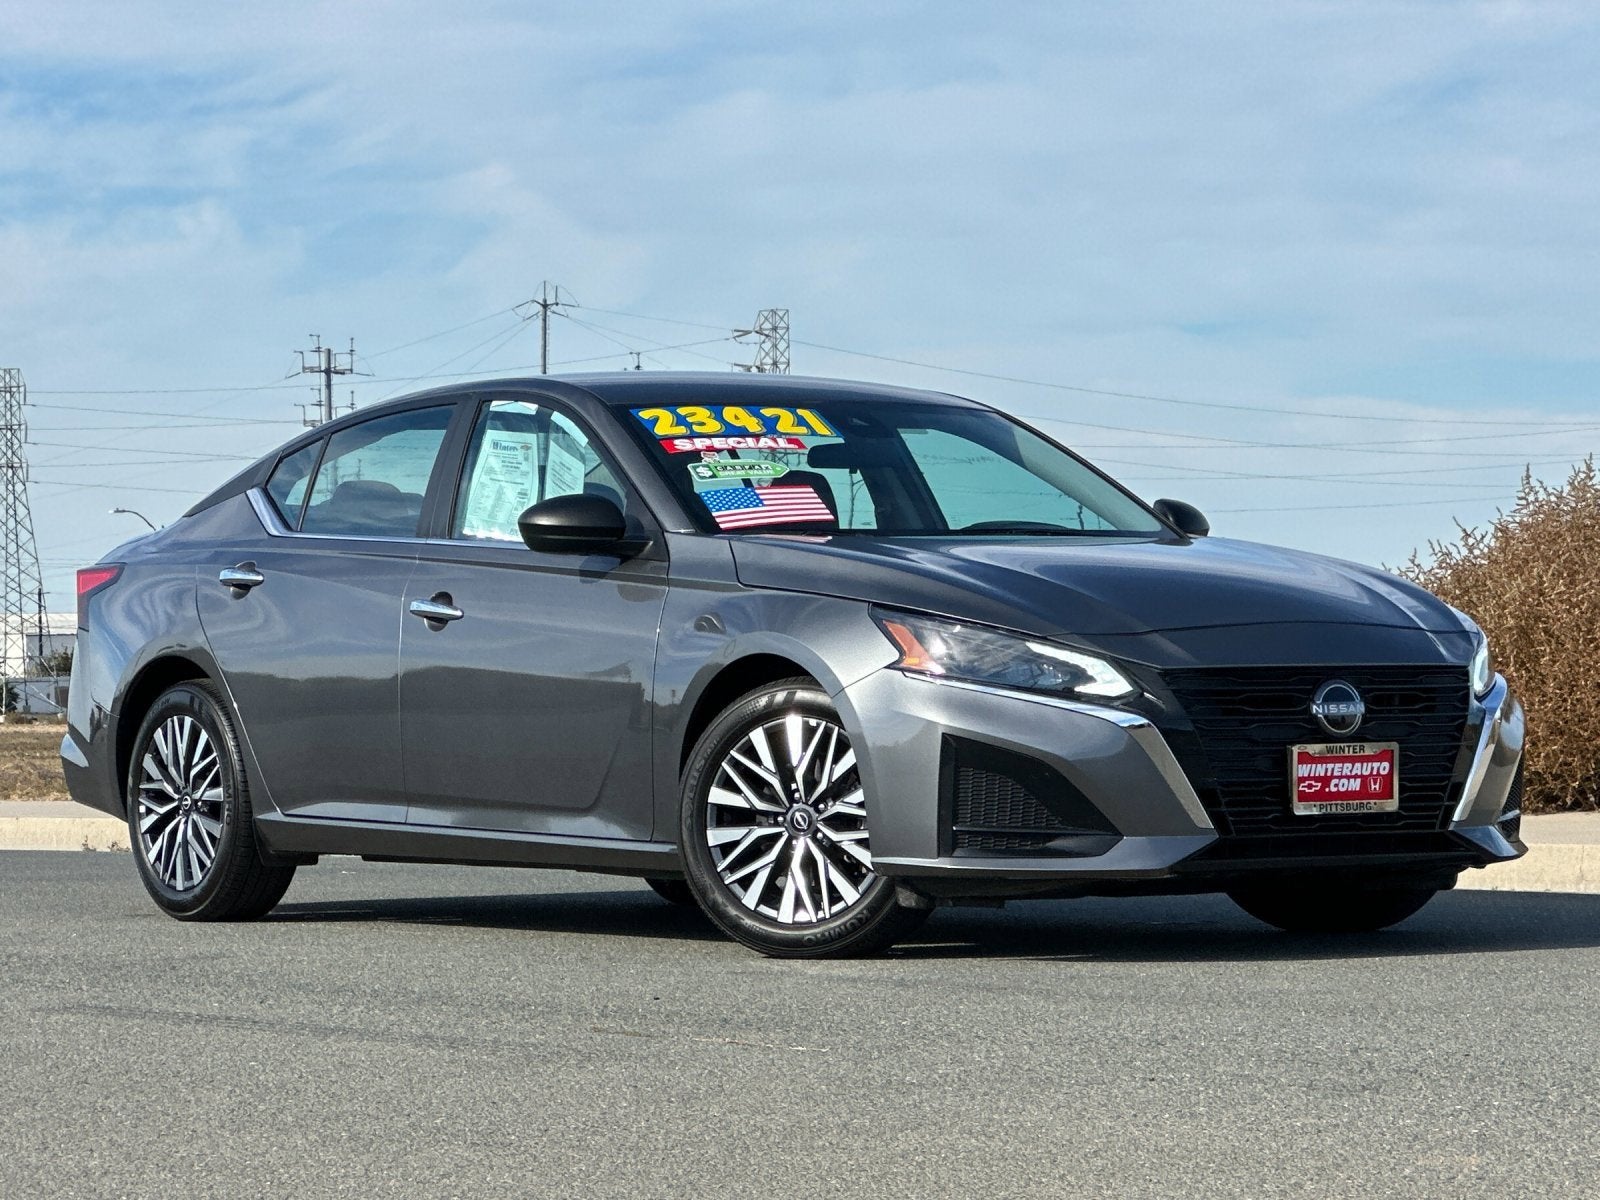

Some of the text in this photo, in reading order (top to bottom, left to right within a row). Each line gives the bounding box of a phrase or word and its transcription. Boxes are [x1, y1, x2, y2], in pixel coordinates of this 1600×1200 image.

[638, 405, 835, 436] 23421
[673, 437, 798, 451] SPECIAL
[714, 463, 773, 472] CARFAX
[1312, 704, 1365, 714] NISSAN
[1325, 744, 1366, 755] WINTER
[1298, 762, 1390, 777] WINTERAUTO
[1325, 779, 1361, 792] .COM
[1318, 801, 1373, 813] PITTSBURG
